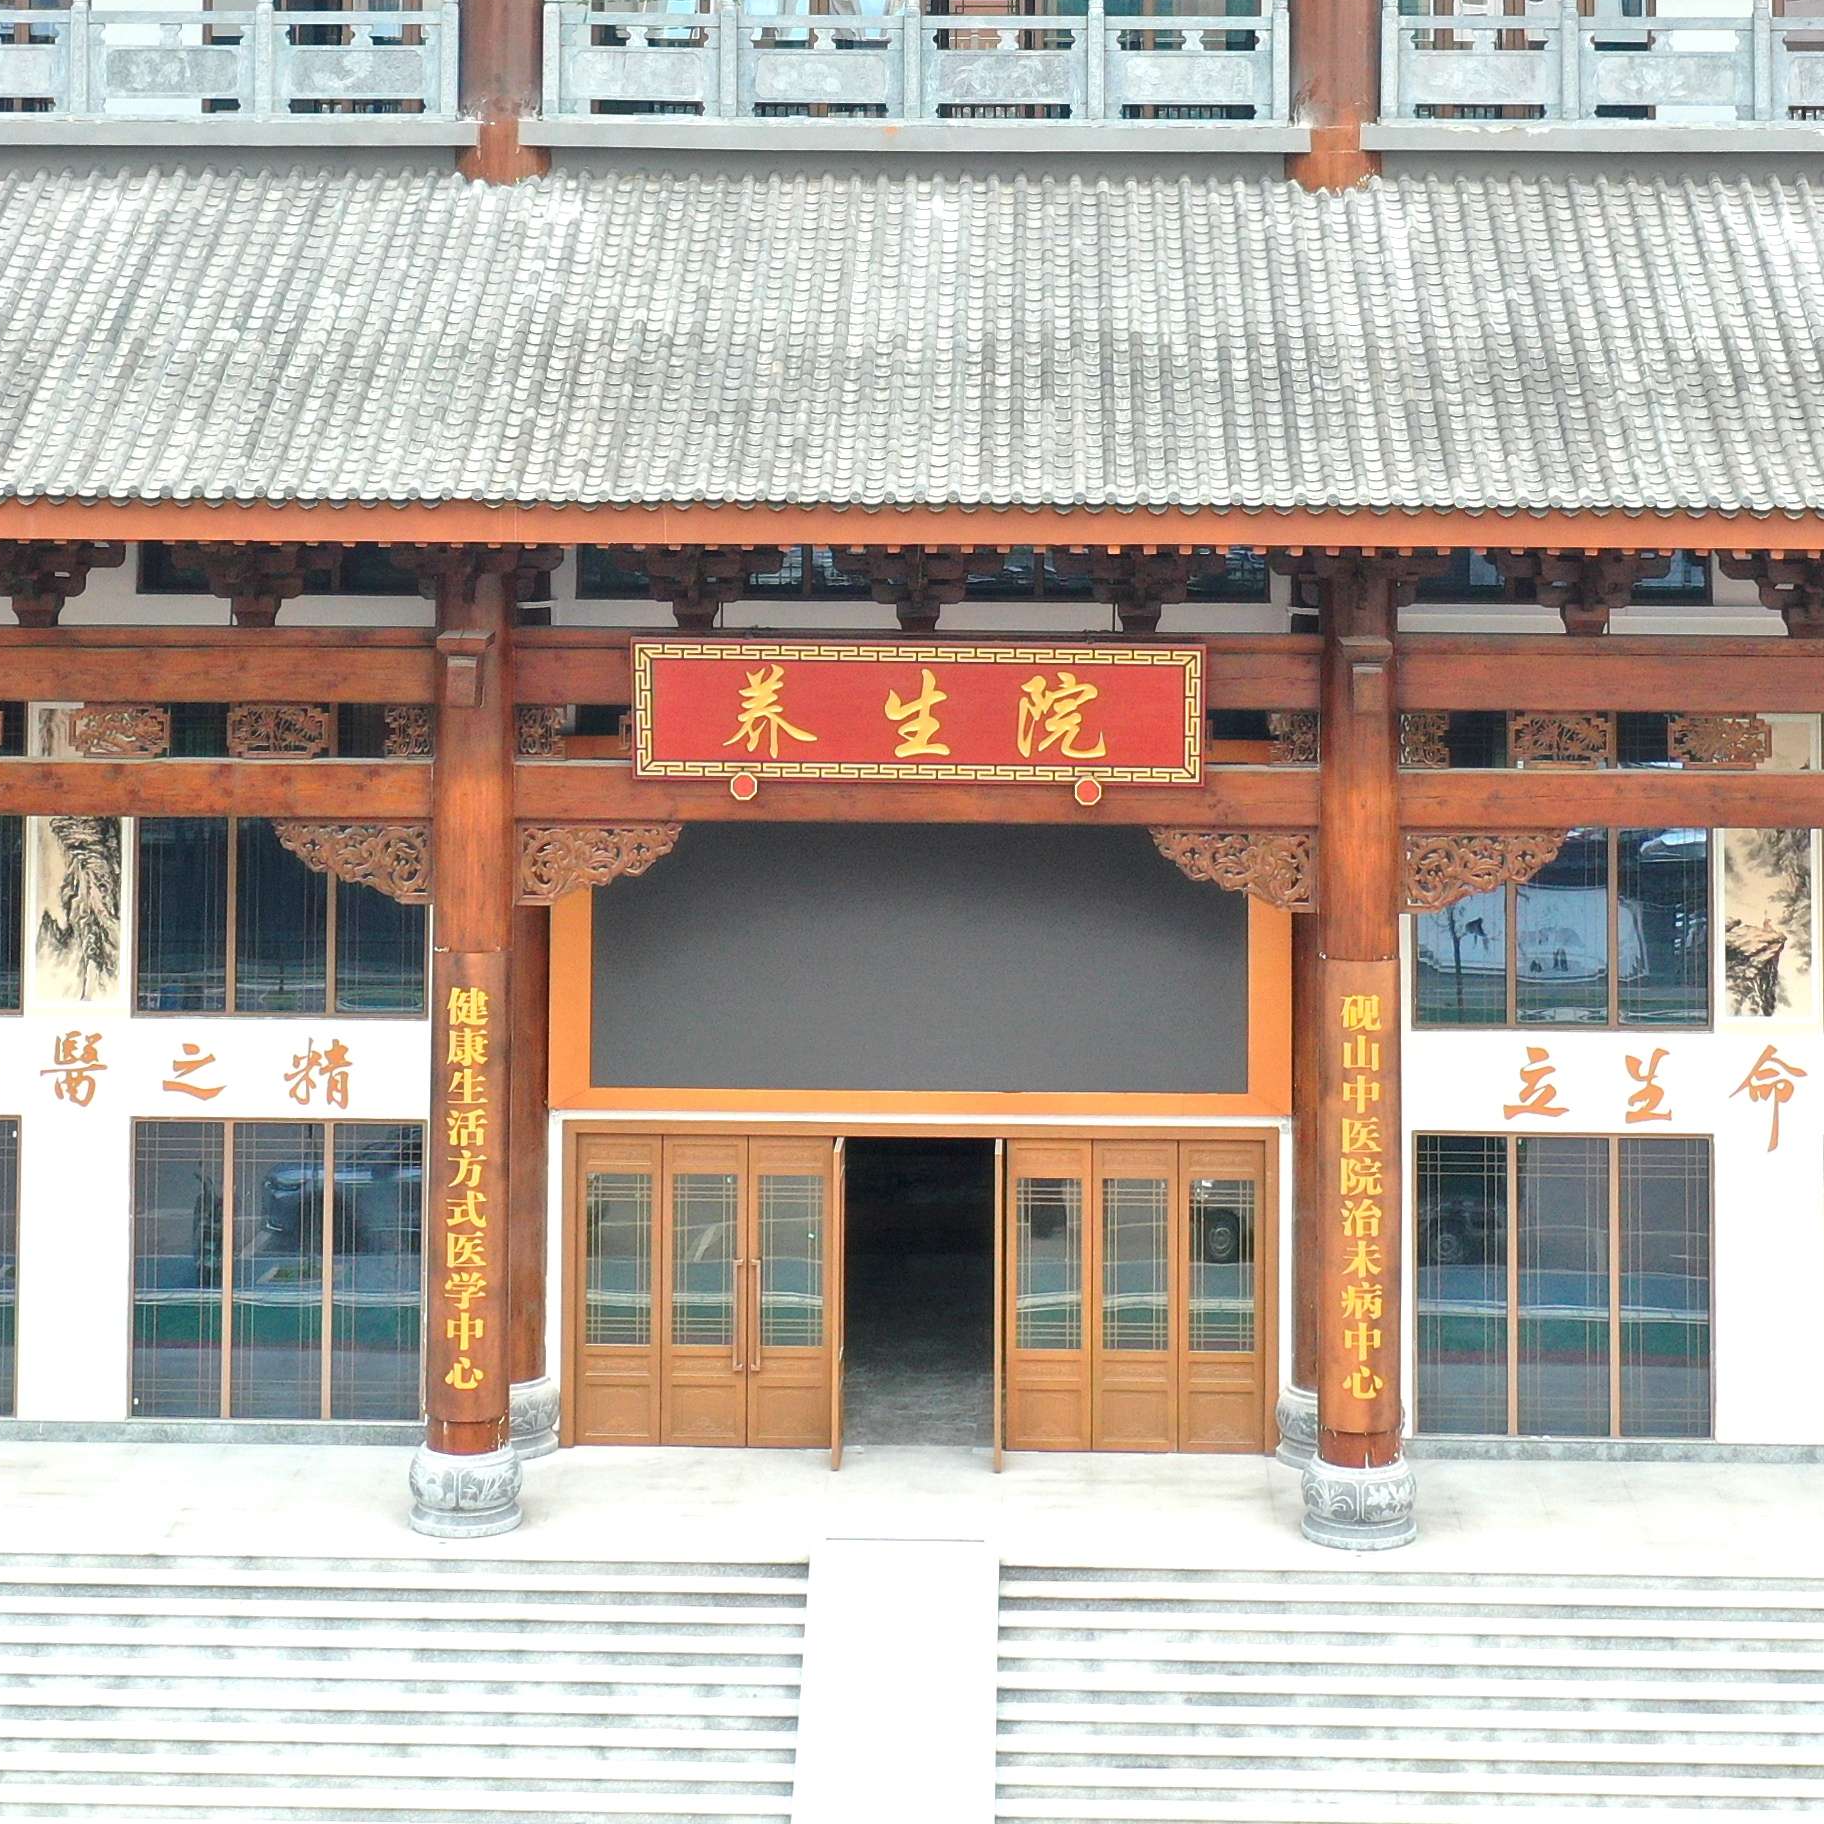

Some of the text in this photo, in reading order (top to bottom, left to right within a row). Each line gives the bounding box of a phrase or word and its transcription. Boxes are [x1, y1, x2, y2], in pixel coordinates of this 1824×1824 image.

[722, 664, 1106, 759] 养生院
[445, 987, 489, 1390] 健康生活方式医学中心
[1340, 994, 1384, 1400] 砚山中医院治未病中心
